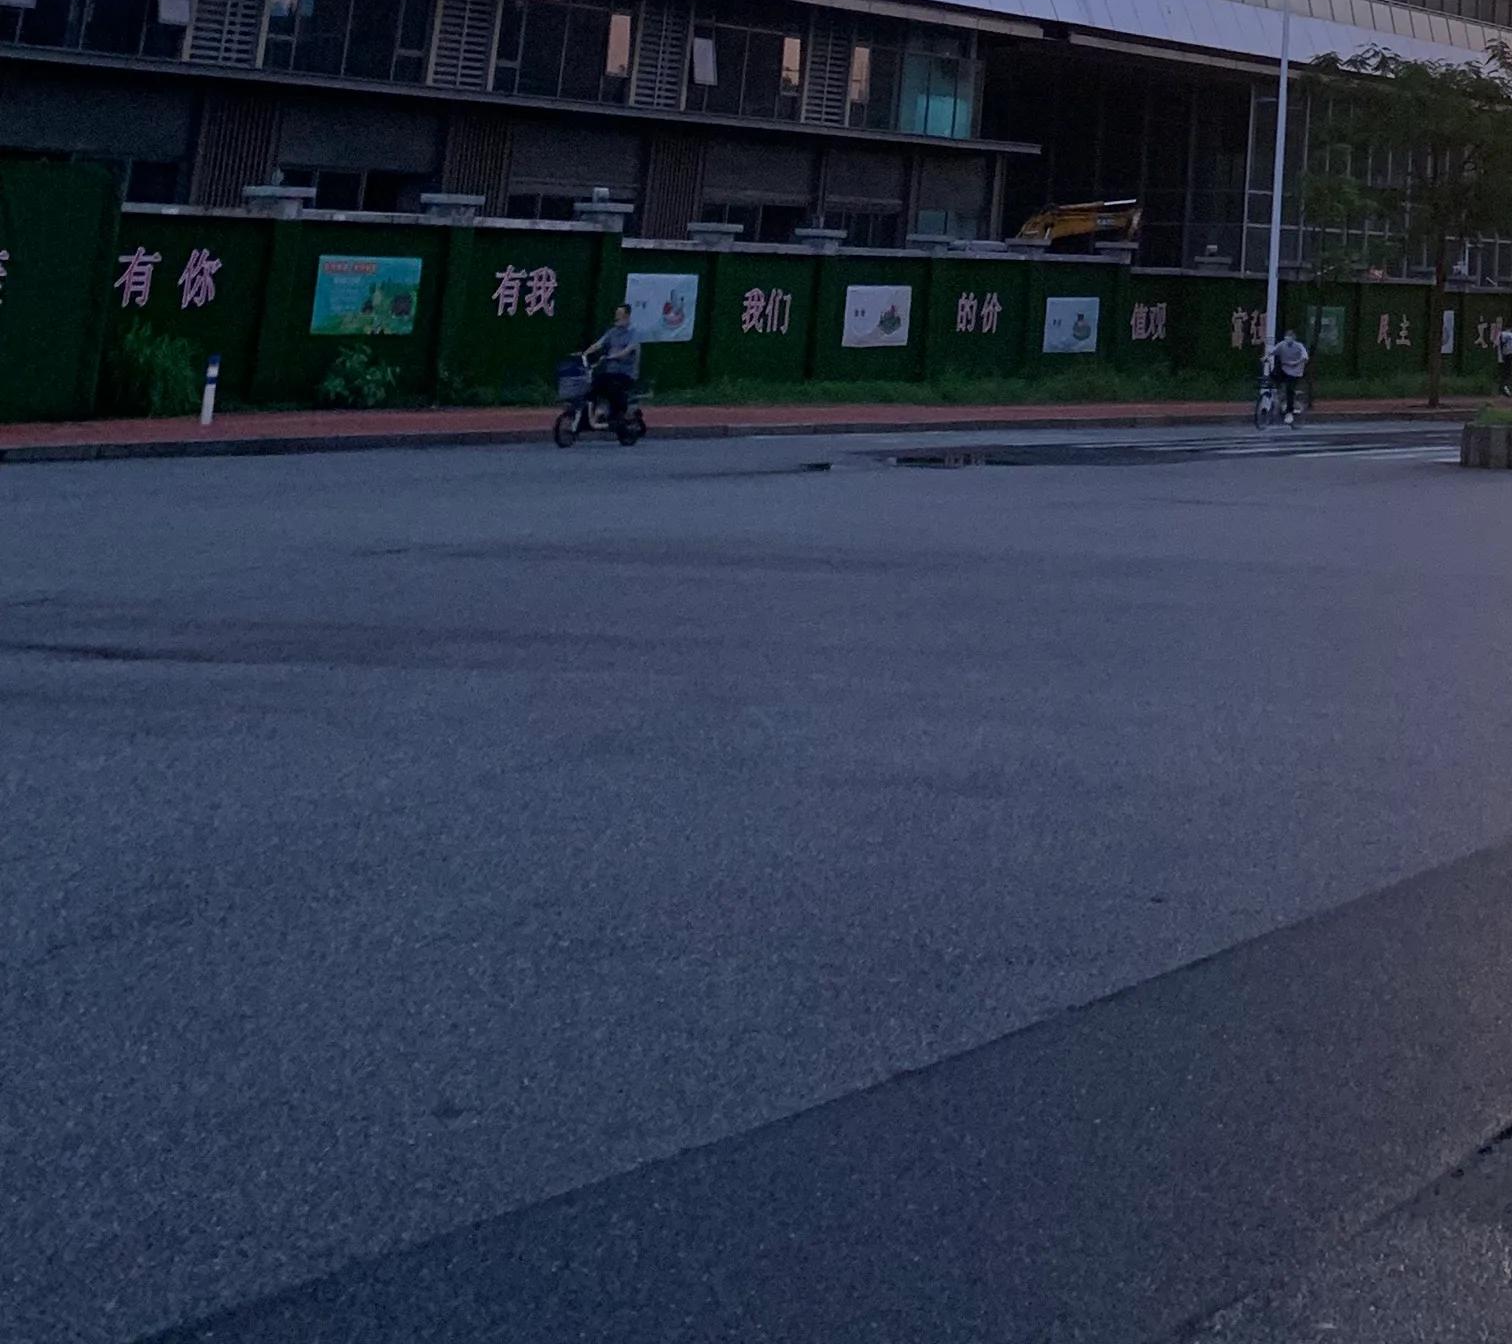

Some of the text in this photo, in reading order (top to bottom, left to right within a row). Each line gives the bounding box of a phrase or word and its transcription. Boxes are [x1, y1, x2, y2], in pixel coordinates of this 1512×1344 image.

[113, 246, 559, 317] 有你 有我
[741, 288, 1168, 341] 我们 的价 值观
[1377, 313, 1411, 350] 民主
